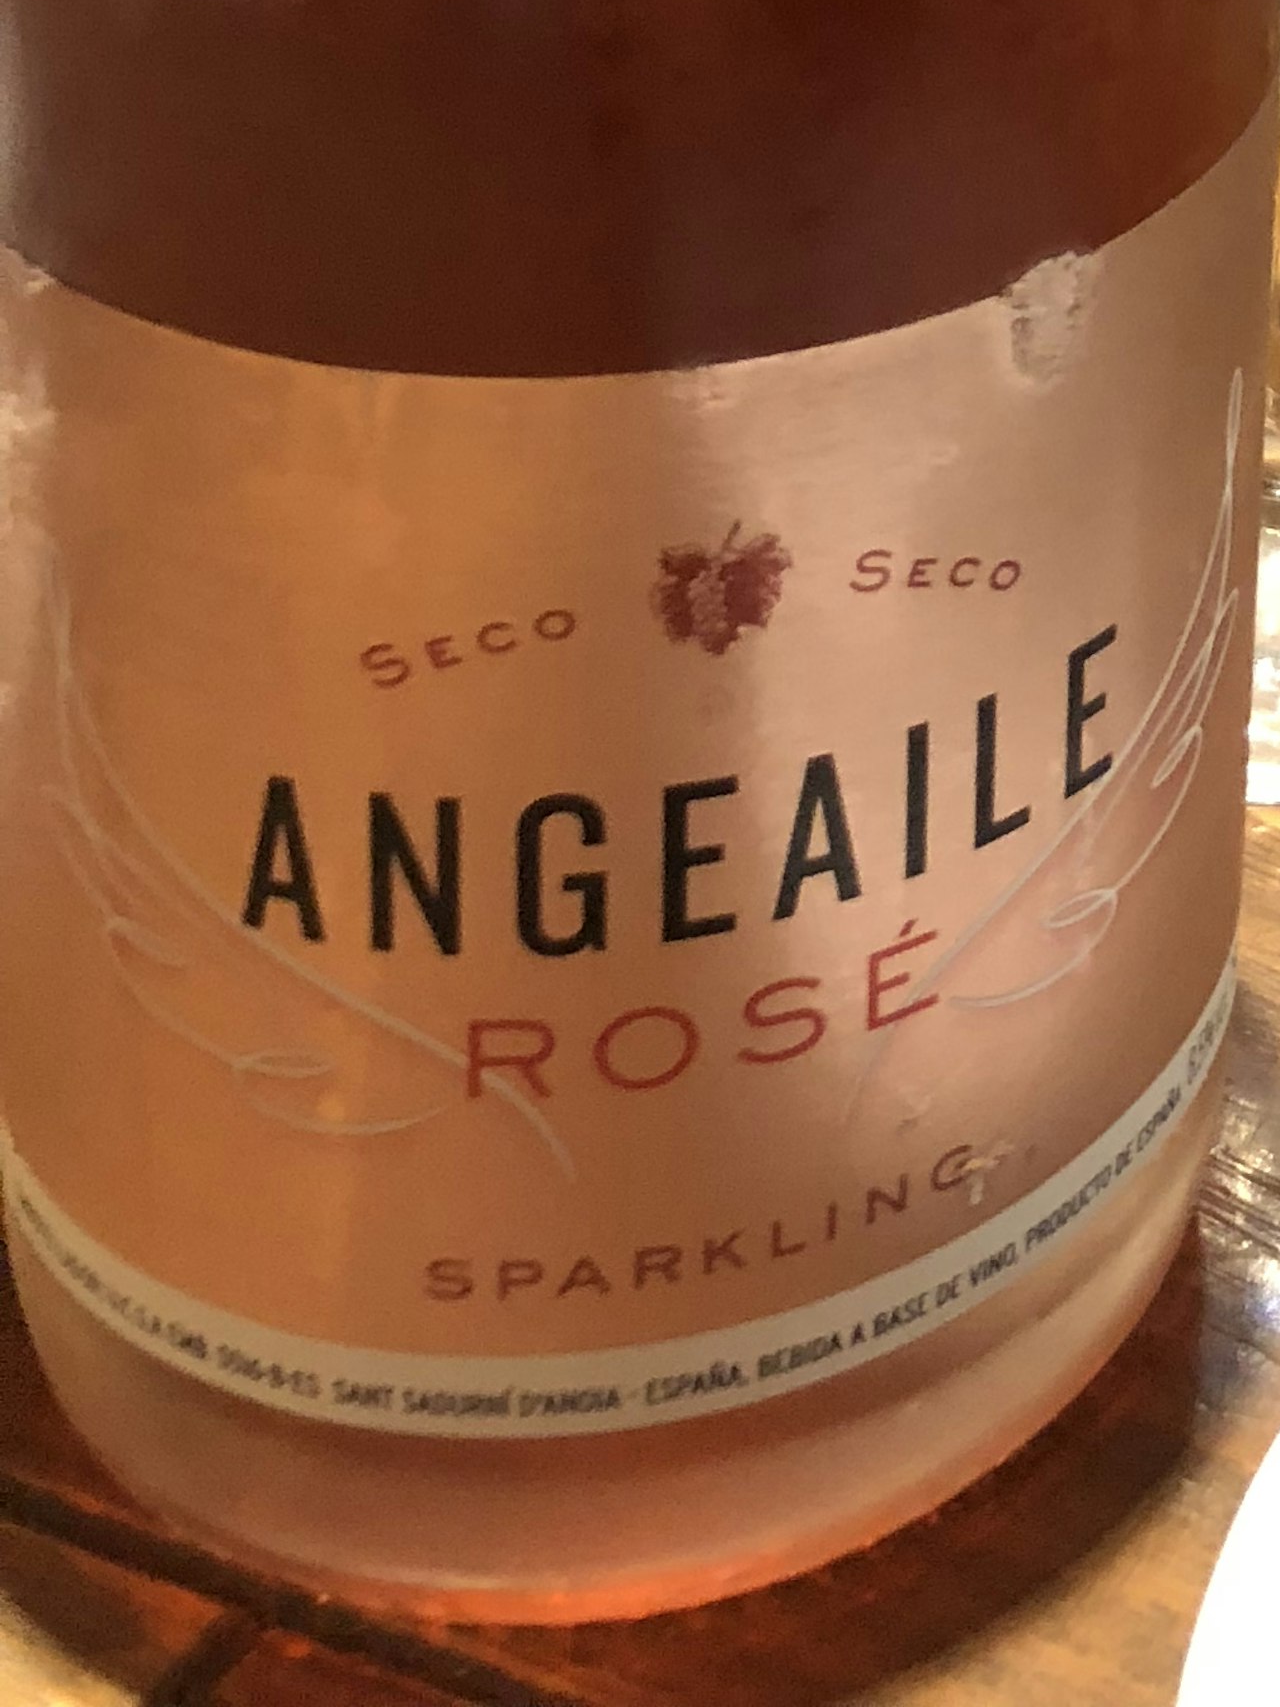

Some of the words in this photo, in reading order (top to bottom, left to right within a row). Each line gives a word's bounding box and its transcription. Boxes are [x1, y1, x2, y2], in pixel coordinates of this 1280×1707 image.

[361, 608, 577, 687] SECO
[850, 549, 1022, 593] SECO
[241, 623, 1118, 957] ANGEAILE
[466, 919, 940, 1101] ROSÉ
[425, 1144, 980, 1302] SPARKLING
[757, 1330, 843, 1383] BEBIDA
[872, 1291, 929, 1339] BASE
[935, 1273, 961, 1309] DE
[1025, 1164, 1113, 1256] PRODUCTO
